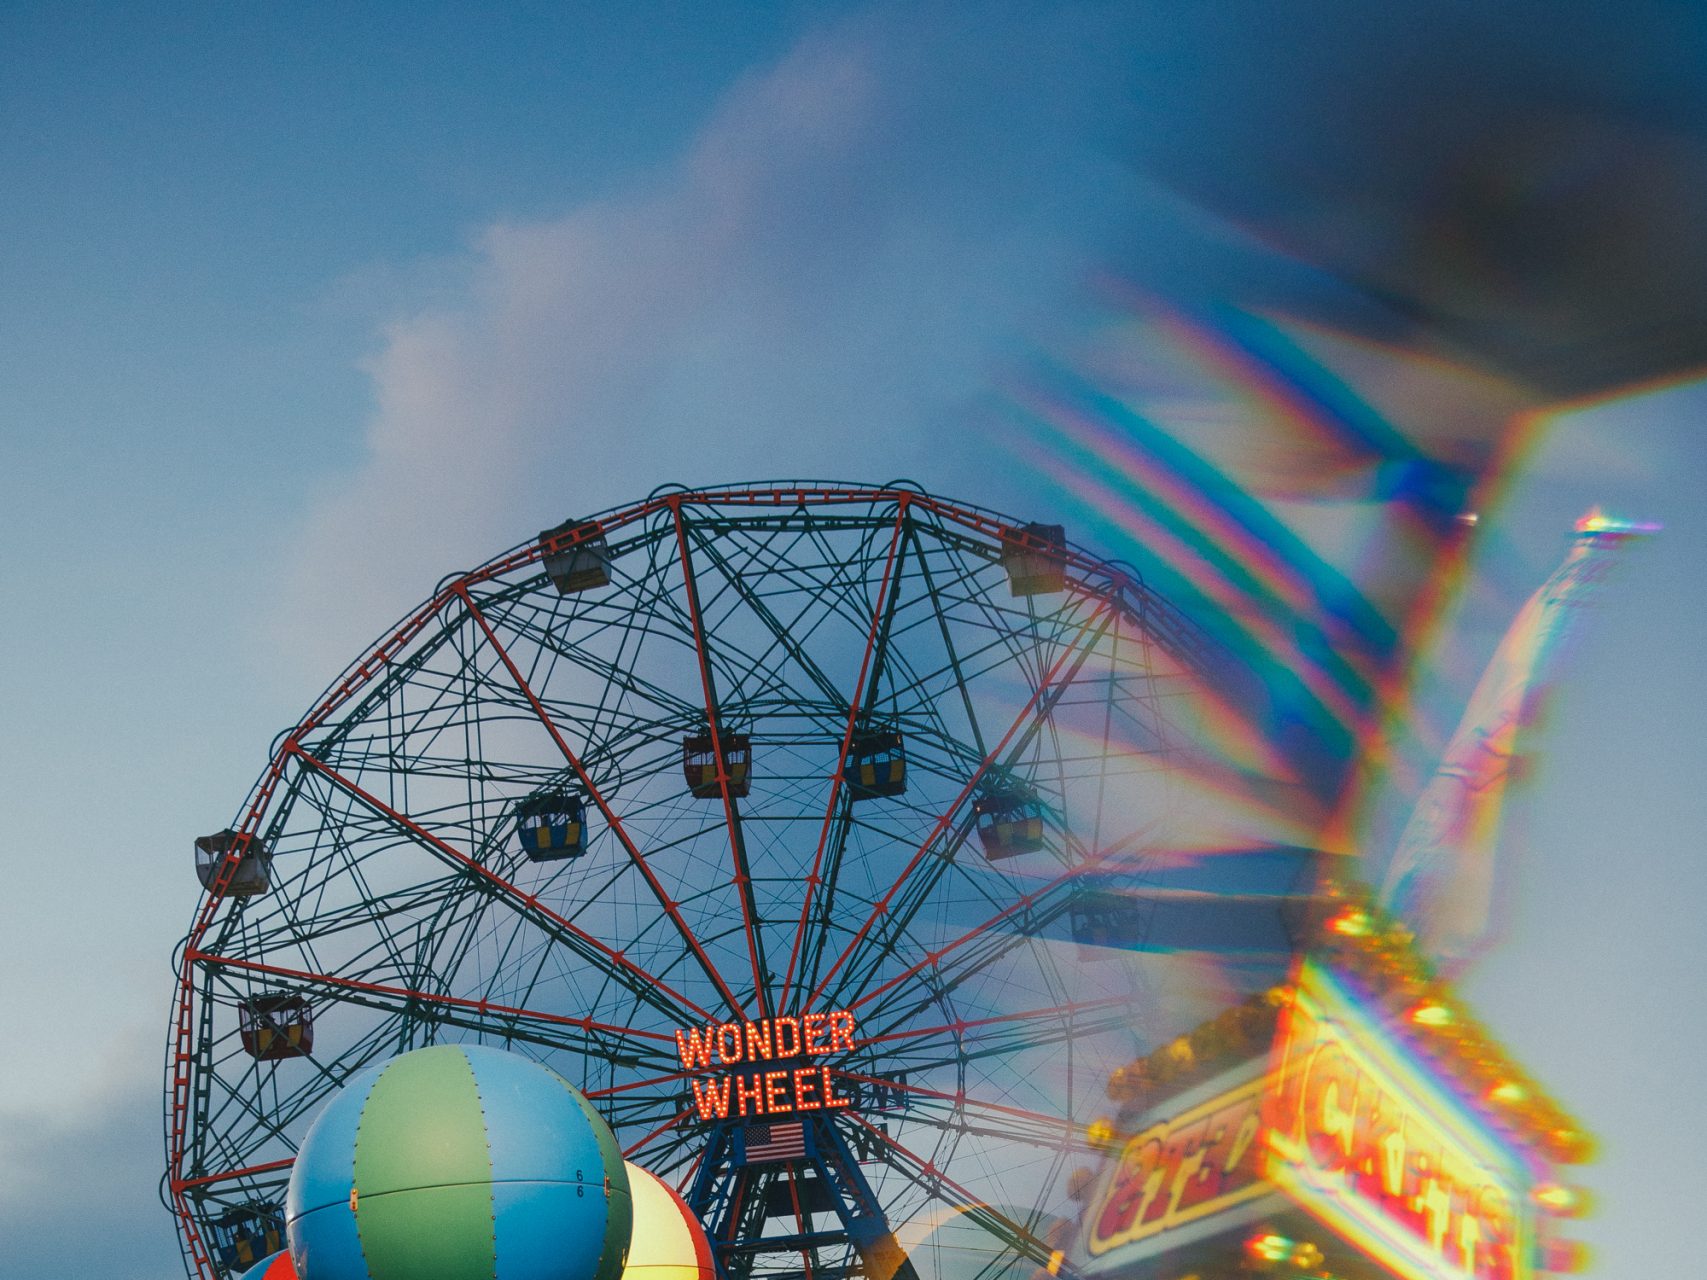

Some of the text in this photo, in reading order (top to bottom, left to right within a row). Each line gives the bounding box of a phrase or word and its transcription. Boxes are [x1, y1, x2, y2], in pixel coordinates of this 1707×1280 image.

[675, 1010, 856, 1068] WONDER
[692, 1066, 849, 1120] WHEEL
[576, 1169, 584, 1181] 6
[577, 1185, 584, 1198] 6
